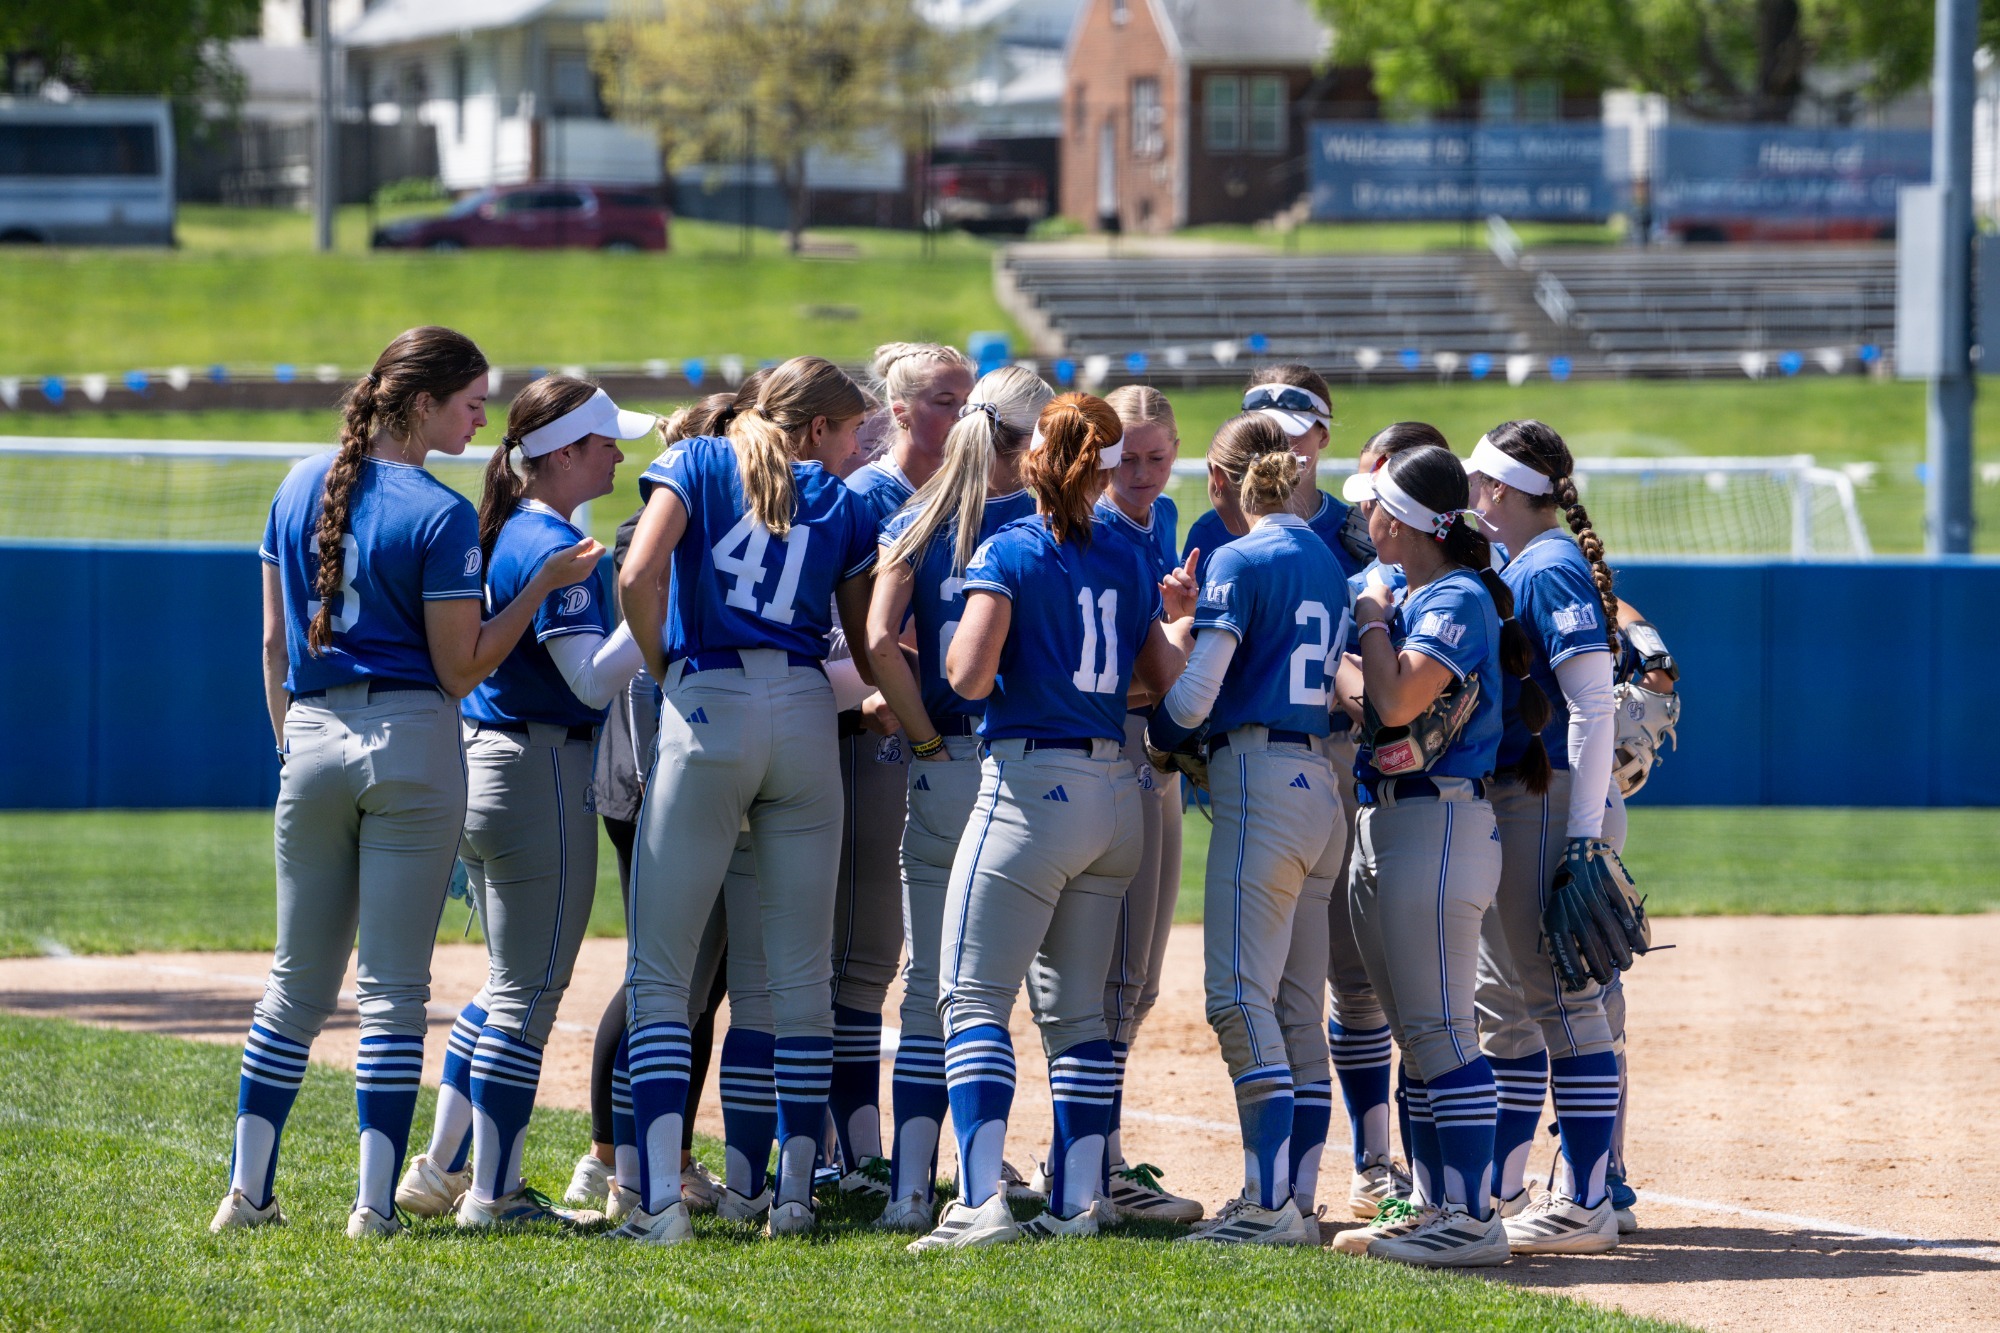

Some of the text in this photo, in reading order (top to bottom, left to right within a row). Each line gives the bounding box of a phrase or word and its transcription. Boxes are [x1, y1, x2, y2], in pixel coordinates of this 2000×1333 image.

[1322, 134, 1431, 165] Welcome
[711, 509, 810, 625] 41
[1072, 586, 1119, 694] 11
[1290, 600, 1350, 710] 24
[1381, 748, 1409, 766] Rawlings
[1554, 932, 1575, 975] EASTON
